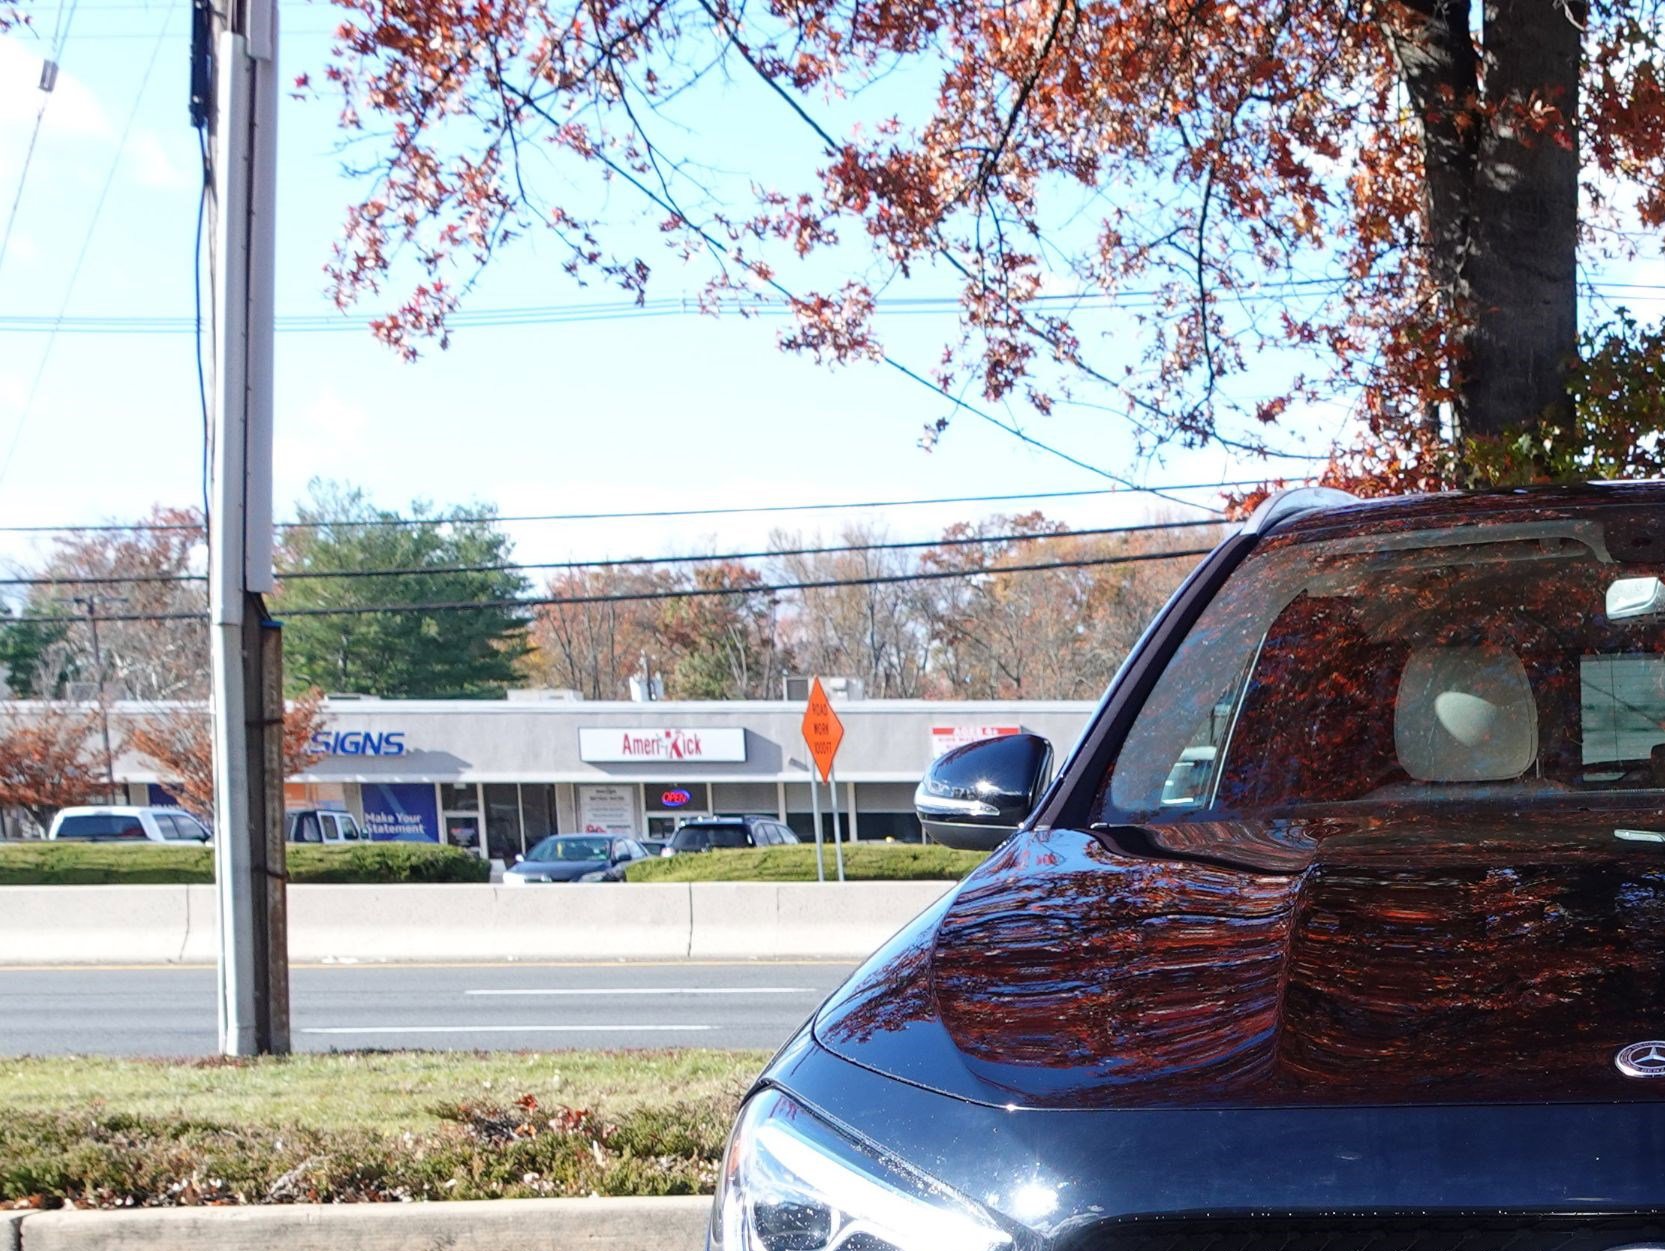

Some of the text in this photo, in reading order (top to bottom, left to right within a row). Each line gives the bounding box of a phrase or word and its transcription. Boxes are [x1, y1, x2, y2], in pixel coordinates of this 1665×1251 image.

[812, 703, 828, 716] ROAD
[813, 722, 829, 736] WORK
[309, 731, 405, 755] SIGNS
[662, 792, 688, 803] OPEN
[365, 812, 422, 823] Make Your
